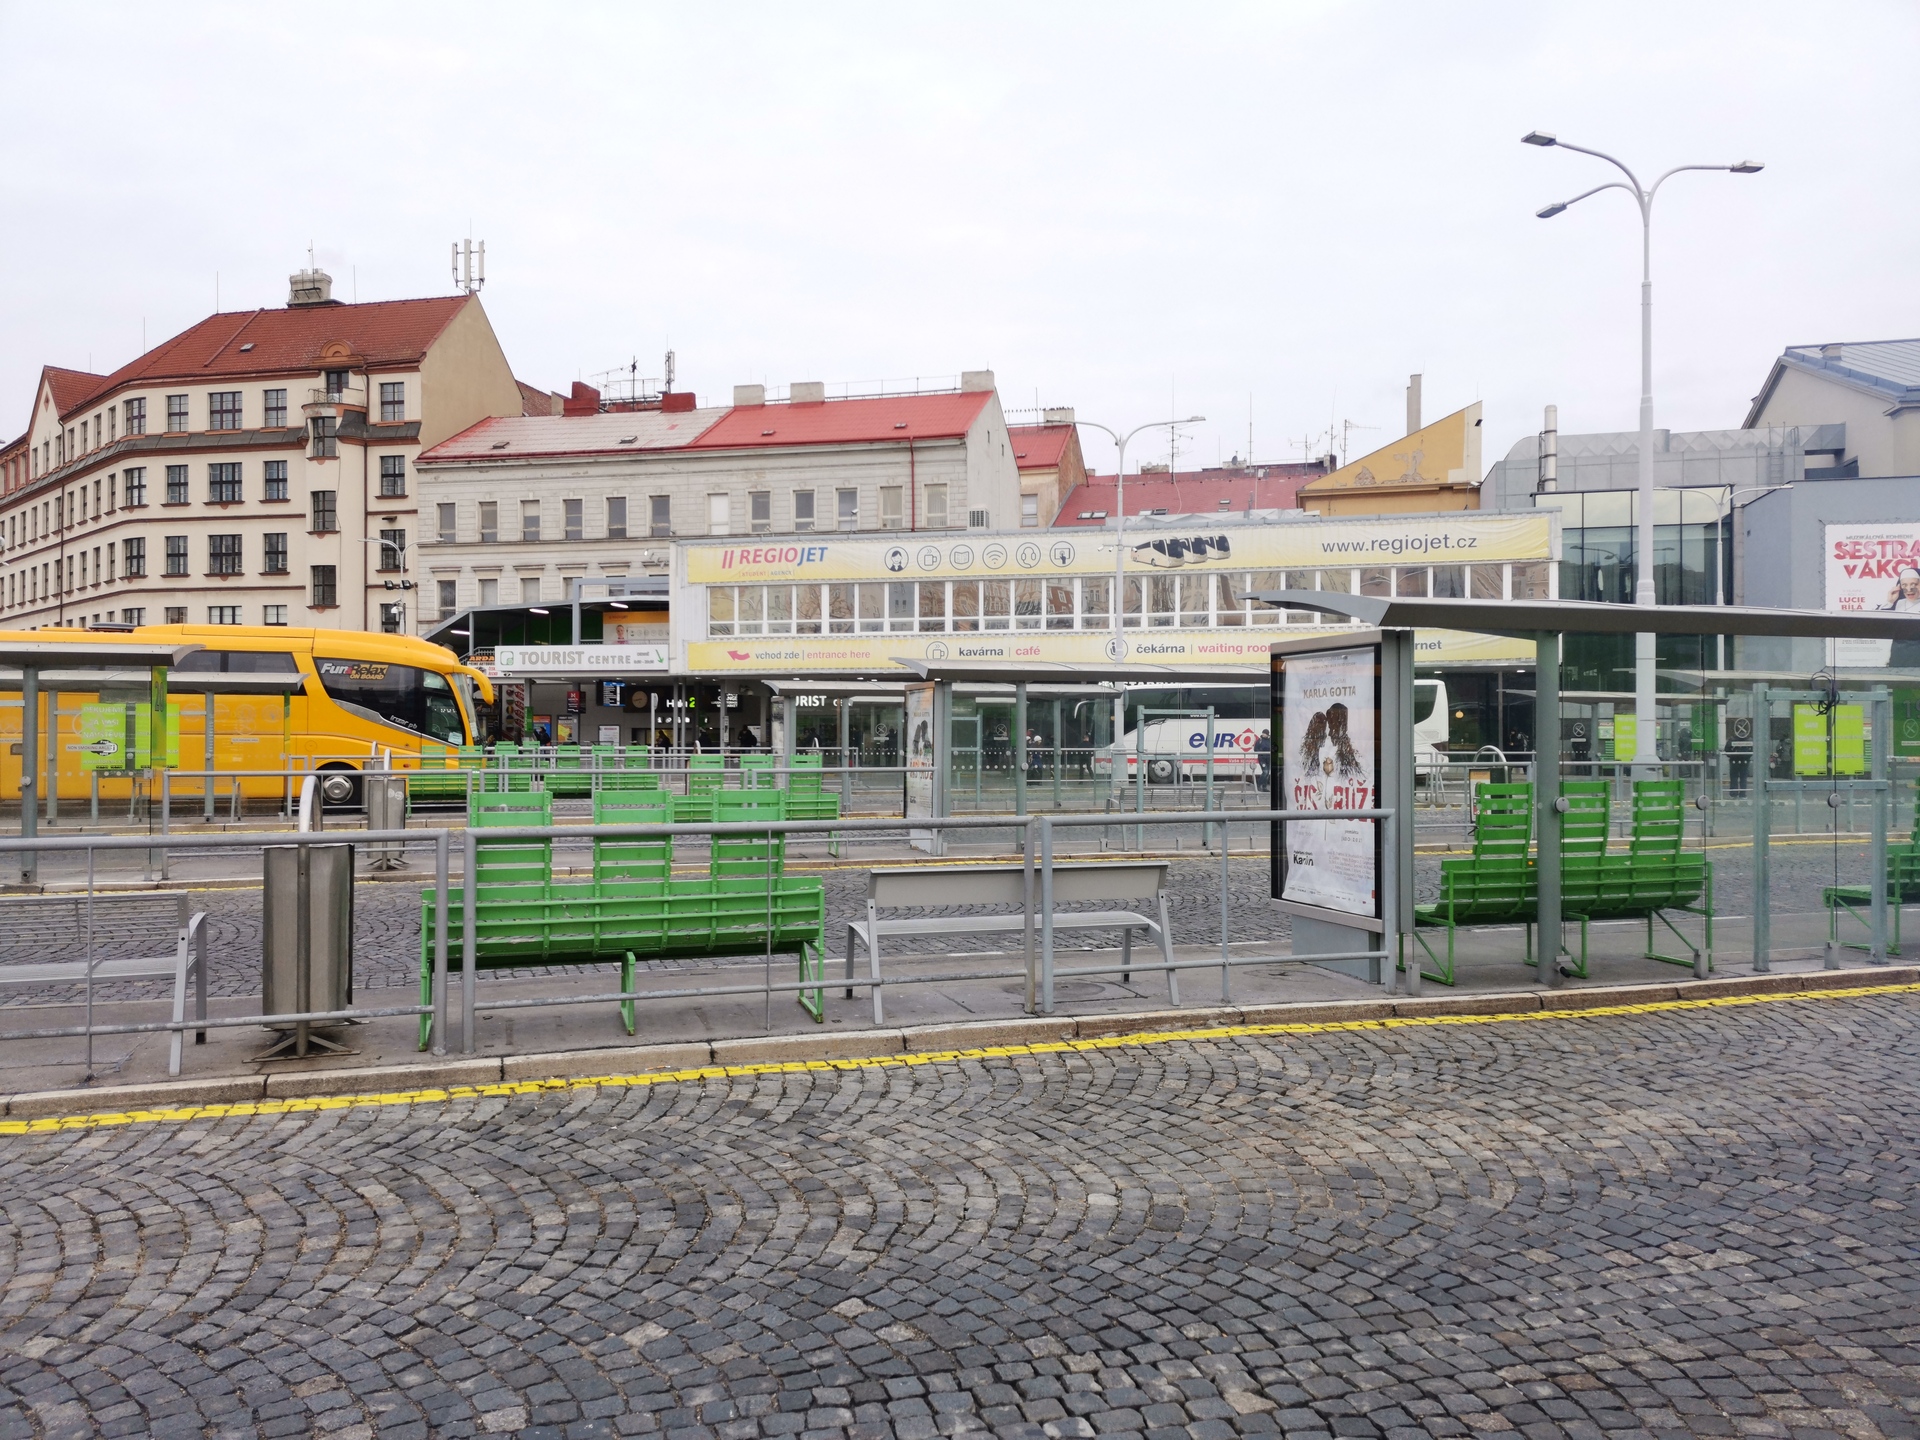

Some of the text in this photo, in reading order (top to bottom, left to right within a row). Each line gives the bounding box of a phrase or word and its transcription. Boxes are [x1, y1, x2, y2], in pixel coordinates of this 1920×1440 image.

[1321, 534, 1478, 555] www.regiojet.cz
[738, 547, 829, 567] REGIOJET
[958, 645, 1041, 657] kavárna café
[1136, 642, 1186, 654] čekárna
[1197, 642, 1244, 655] waiting
[1414, 640, 1443, 650] rnet
[519, 651, 631, 666] TOURIST CENTRE
[755, 650, 871, 660] vchod zde entrance here
[1303, 685, 1357, 699] KARLA GOTTA
[689, 696, 696, 708] 2
